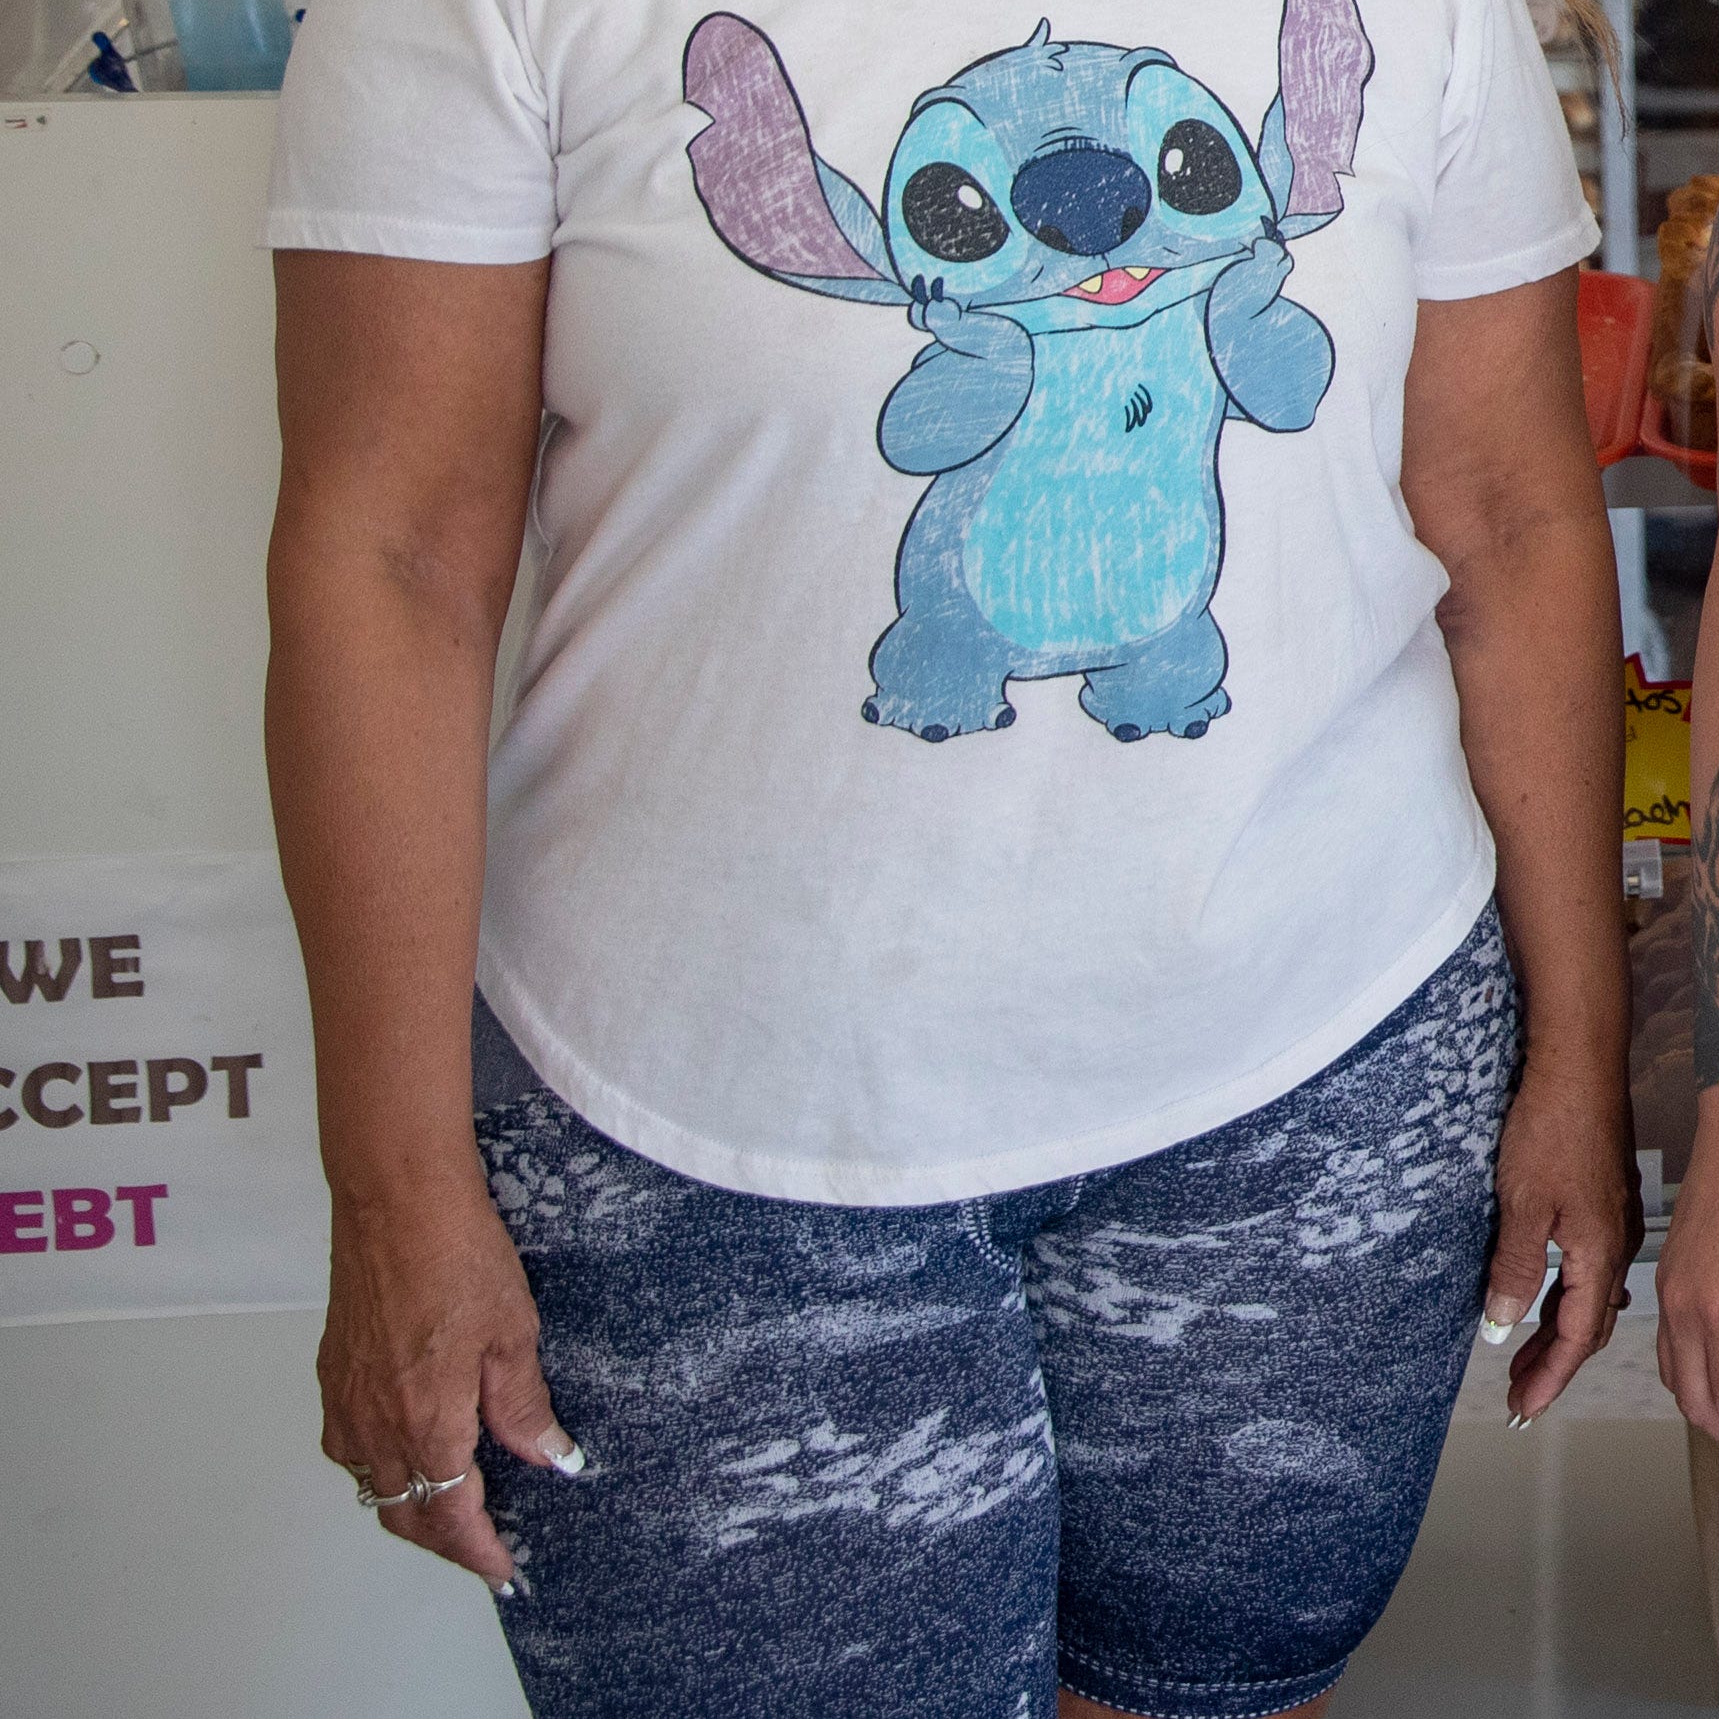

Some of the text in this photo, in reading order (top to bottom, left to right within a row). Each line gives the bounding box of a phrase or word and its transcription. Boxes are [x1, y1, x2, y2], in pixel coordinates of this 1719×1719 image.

[1624, 687, 1683, 715] tos
[1624, 794, 1690, 830] ach
[0, 934, 145, 1004] WE
[0, 1053, 263, 1130] CEPT
[0, 1184, 169, 1254] EBT
